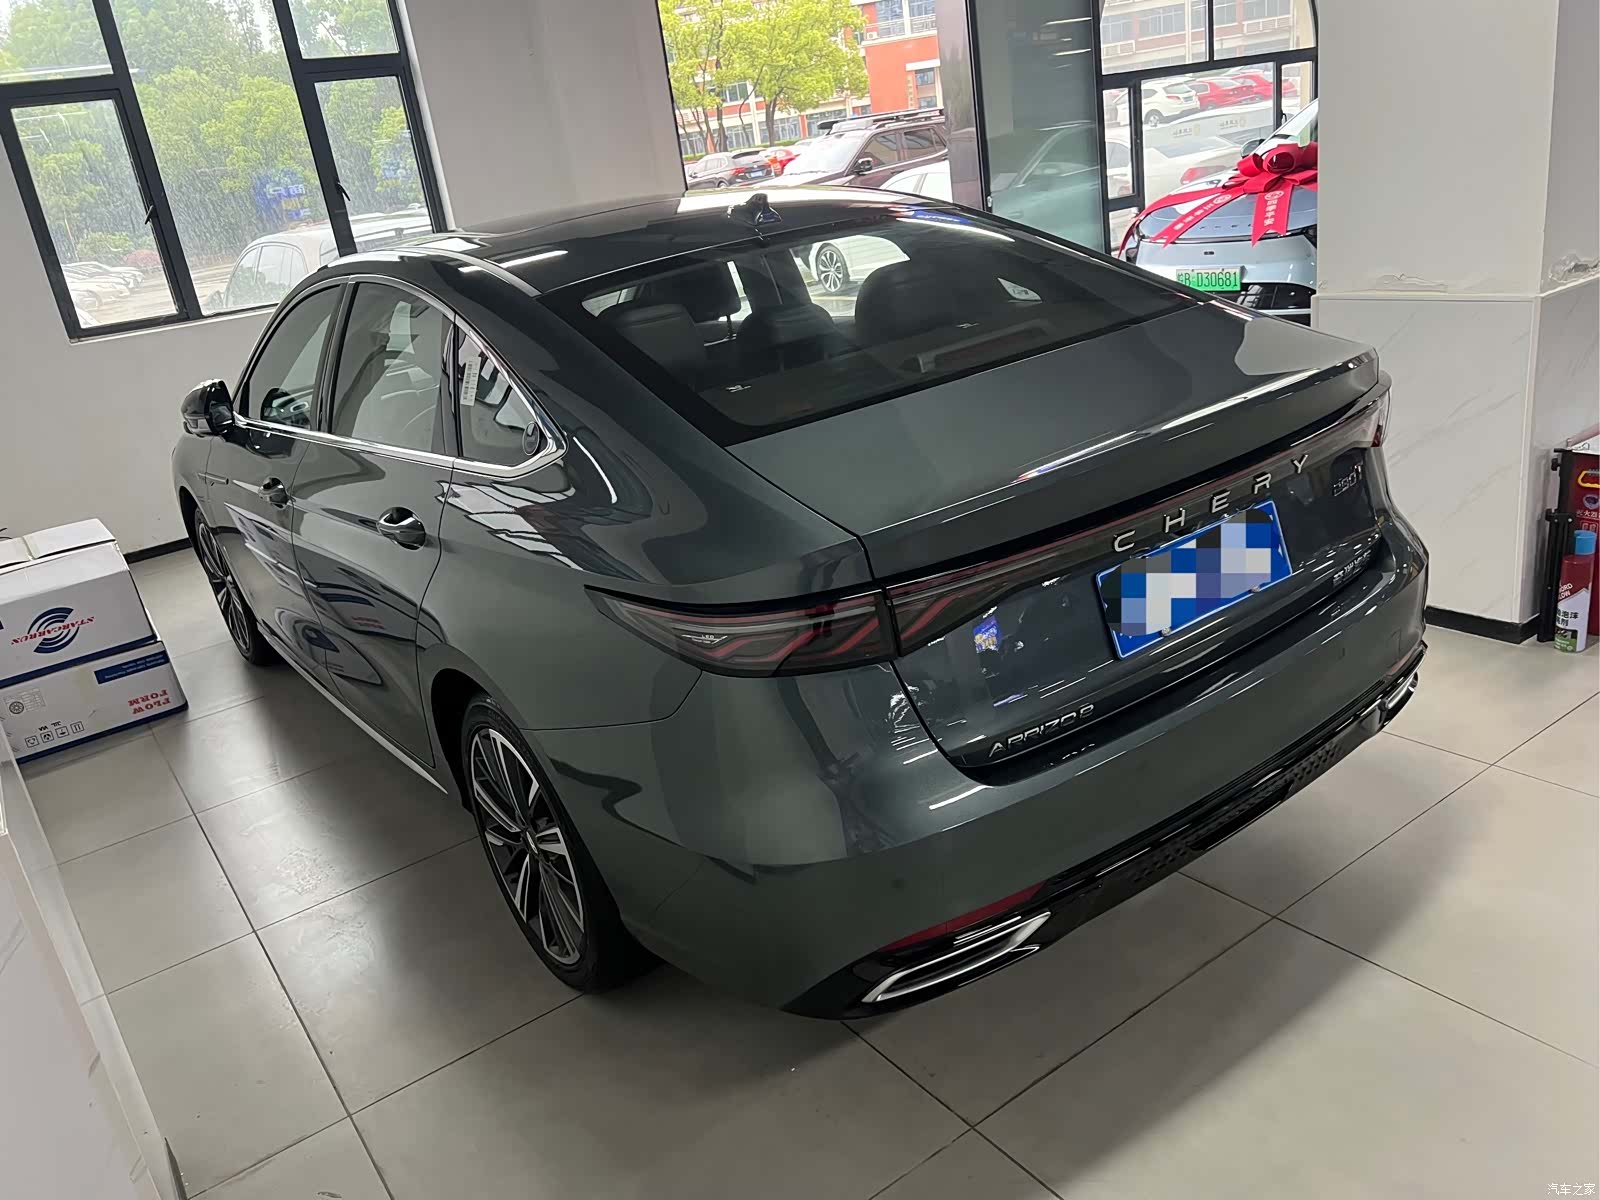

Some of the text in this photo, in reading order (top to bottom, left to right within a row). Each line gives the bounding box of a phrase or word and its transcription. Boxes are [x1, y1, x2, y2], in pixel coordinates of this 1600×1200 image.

[1196, 271, 1238, 288] D30681
[1114, 455, 1308, 552] CHERY
[128, 689, 168, 706] FORM
[132, 697, 171, 714] FLOW
[989, 712, 1077, 757] ARRIZO
